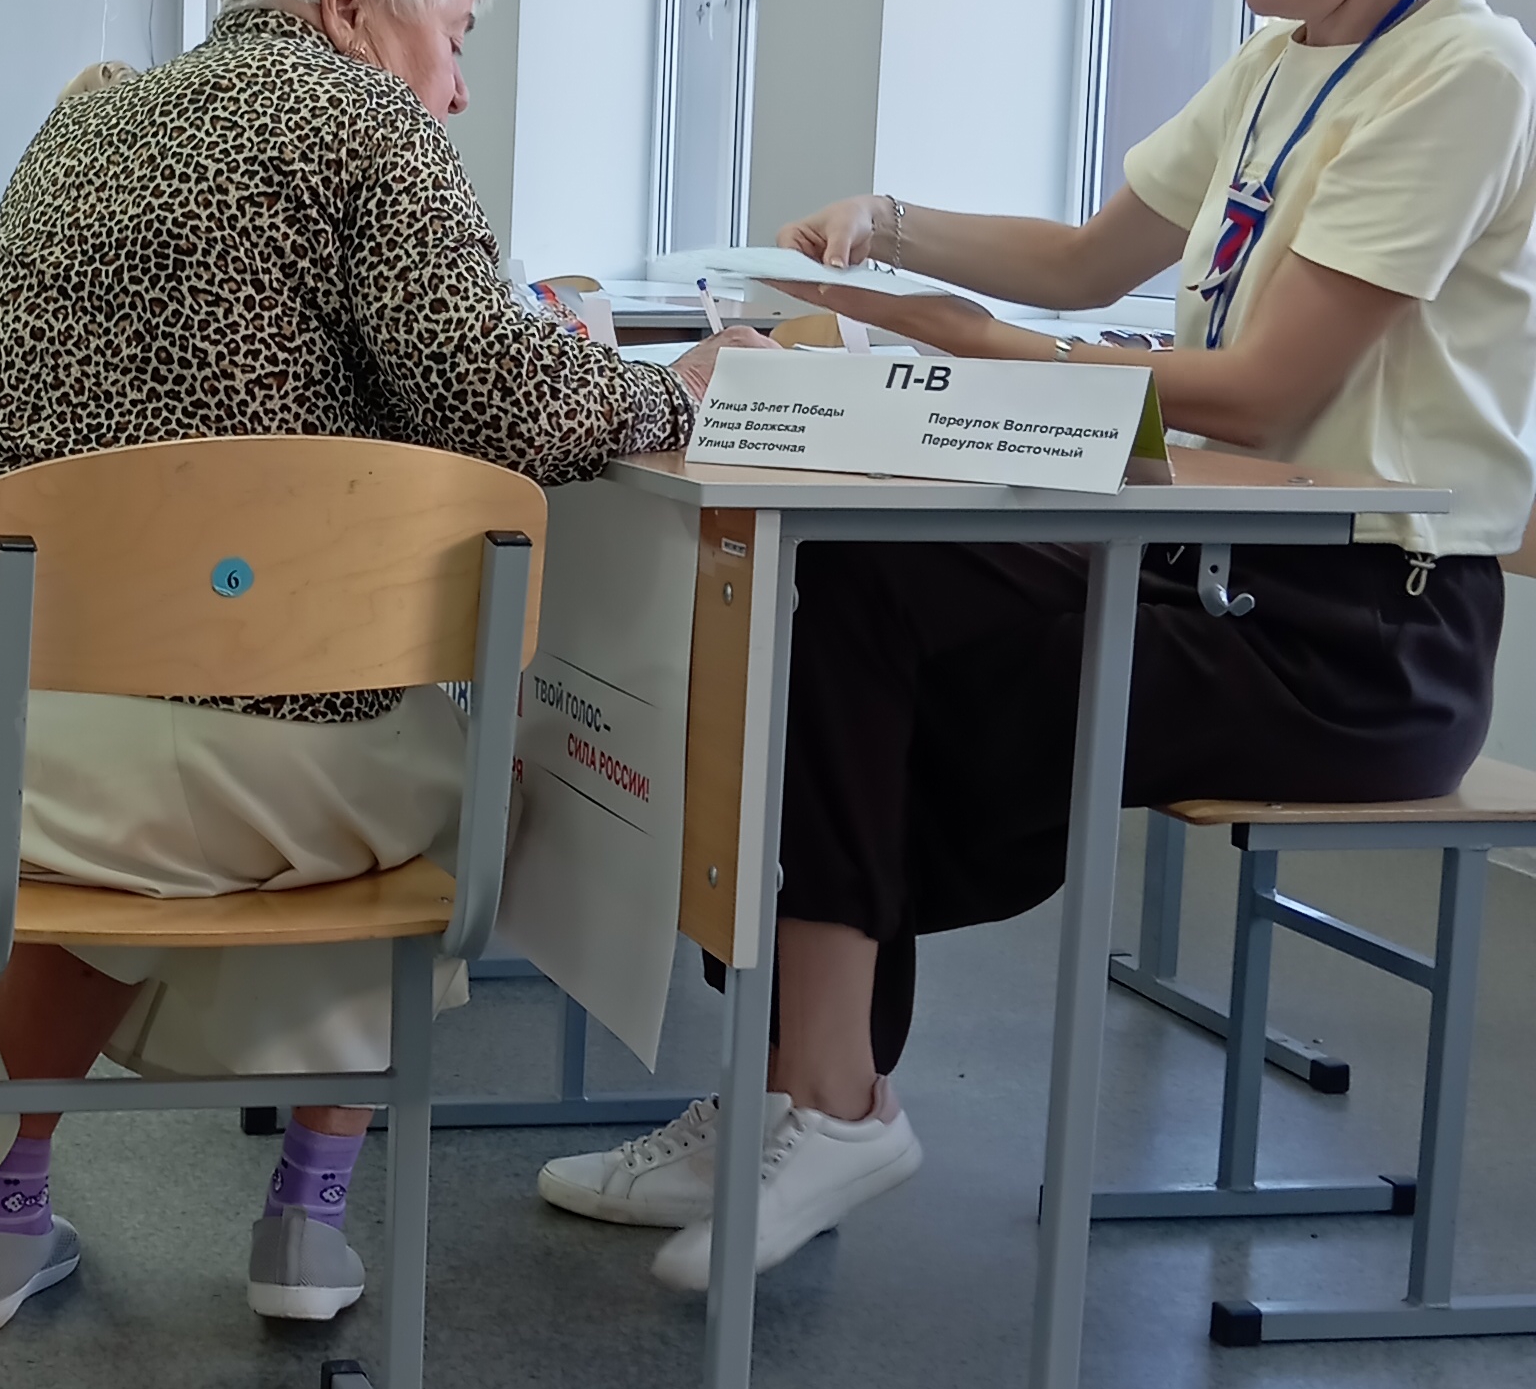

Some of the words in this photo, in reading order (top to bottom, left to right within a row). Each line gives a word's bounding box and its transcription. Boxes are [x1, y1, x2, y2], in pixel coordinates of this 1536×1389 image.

[885, 363, 952, 391] П-В
[709, 398, 748, 413] Улица
[750, 401, 790, 414] 30-лет
[791, 403, 845, 418] Победы
[703, 416, 742, 430] Улица
[744, 420, 806, 434] Волжская
[928, 412, 1000, 430] Переулок
[1003, 419, 1119, 440] Волгоградский
[697, 435, 735, 450] Улица
[738, 438, 806, 453] Восточная
[921, 433, 994, 451] Переулок
[996, 440, 1084, 458] Восточный
[226, 569, 240, 590] 6
[534, 676, 563, 712] ТВОЙ
[565, 691, 602, 732] ГОЛОС
[567, 732, 597, 772] СИЛА
[598, 749, 651, 803] РОССИИ!
